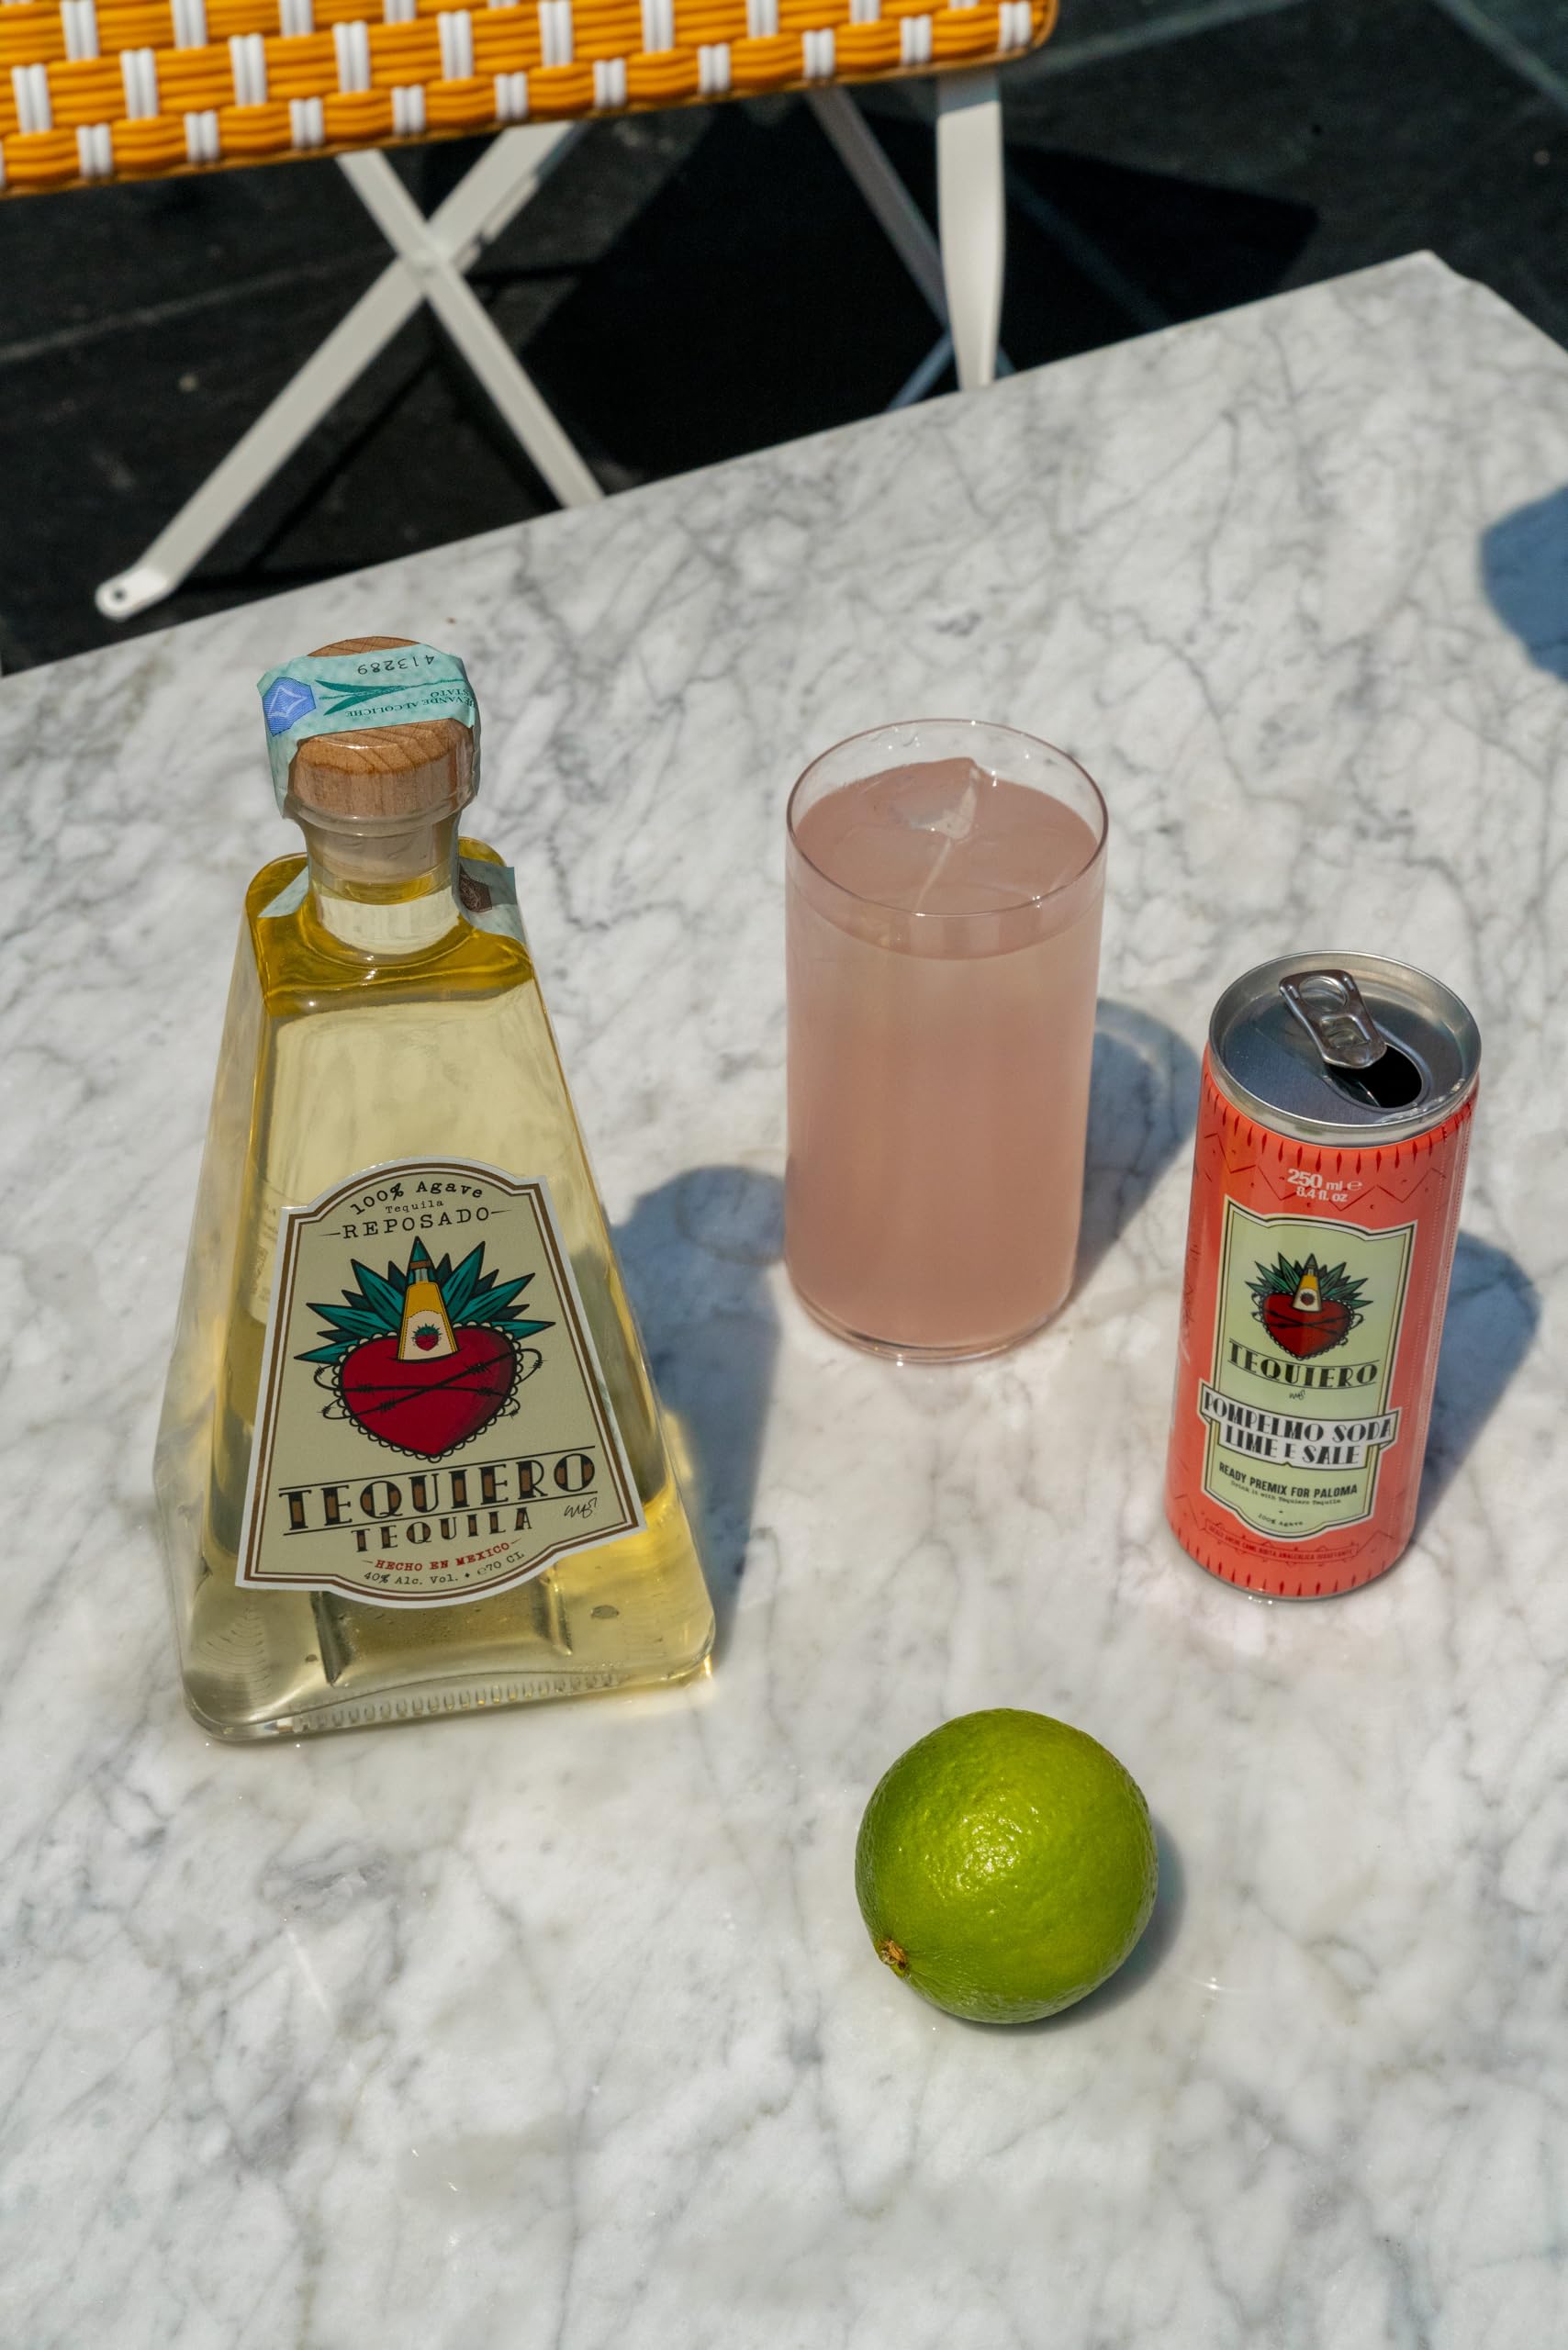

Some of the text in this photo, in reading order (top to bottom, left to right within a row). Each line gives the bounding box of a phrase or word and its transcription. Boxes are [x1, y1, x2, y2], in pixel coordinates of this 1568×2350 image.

[357, 655, 434, 675] 413289
[345, 702, 418, 717] ALCOLICHE
[1287, 1168, 1323, 1189] 250
[1326, 1181, 1343, 1191] ml
[1296, 1186, 1316, 1199] 8.4
[1332, 1193, 1348, 1202] oz
[350, 1181, 483, 1215] 100% Agave
[386, 1199, 444, 1214] Tequila
[342, 1206, 489, 1239] REPOSADO
[1229, 1340, 1377, 1388] TEQUIERO
[1204, 1392, 1392, 1443] POMPELMO SODA
[1226, 1426, 1360, 1465] LIME E SALE
[279, 1453, 595, 1530] TEQUIERO
[1219, 1461, 1358, 1498] READY PREMIX FOR PALOMA
[352, 1507, 532, 1552] TEQUILA
[364, 1572, 390, 1583] 40%
[395, 1576, 422, 1585] Alc.
[431, 1573, 458, 1583] Vol.
[507, 1550, 524, 1563] CL
[375, 1542, 510, 1572] HECHO EN MEXICO
